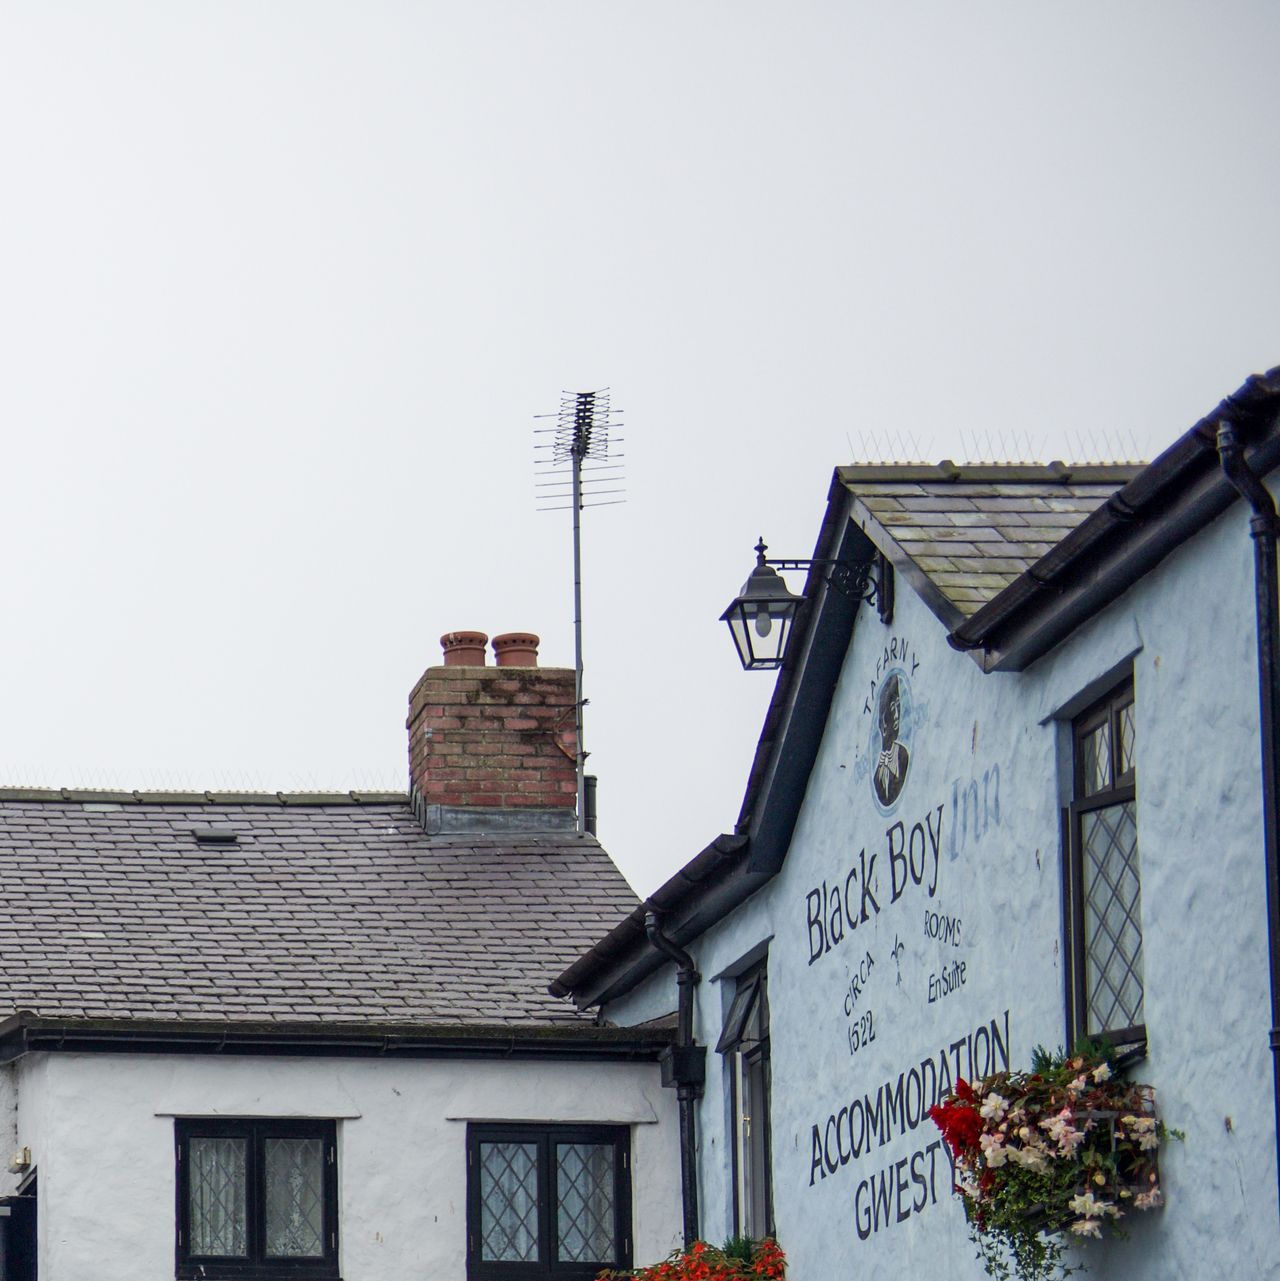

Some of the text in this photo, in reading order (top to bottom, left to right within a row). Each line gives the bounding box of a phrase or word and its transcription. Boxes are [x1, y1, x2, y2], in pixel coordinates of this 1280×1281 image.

[863, 637, 920, 715] TAFARN Y
[806, 763, 1002, 966] Black Boy Inn
[924, 910, 962, 947] ROOMS
[844, 951, 875, 1017] CIRCA
[848, 1010, 876, 1056] 1522
[809, 1009, 1010, 1187] ACCOMMODATION
